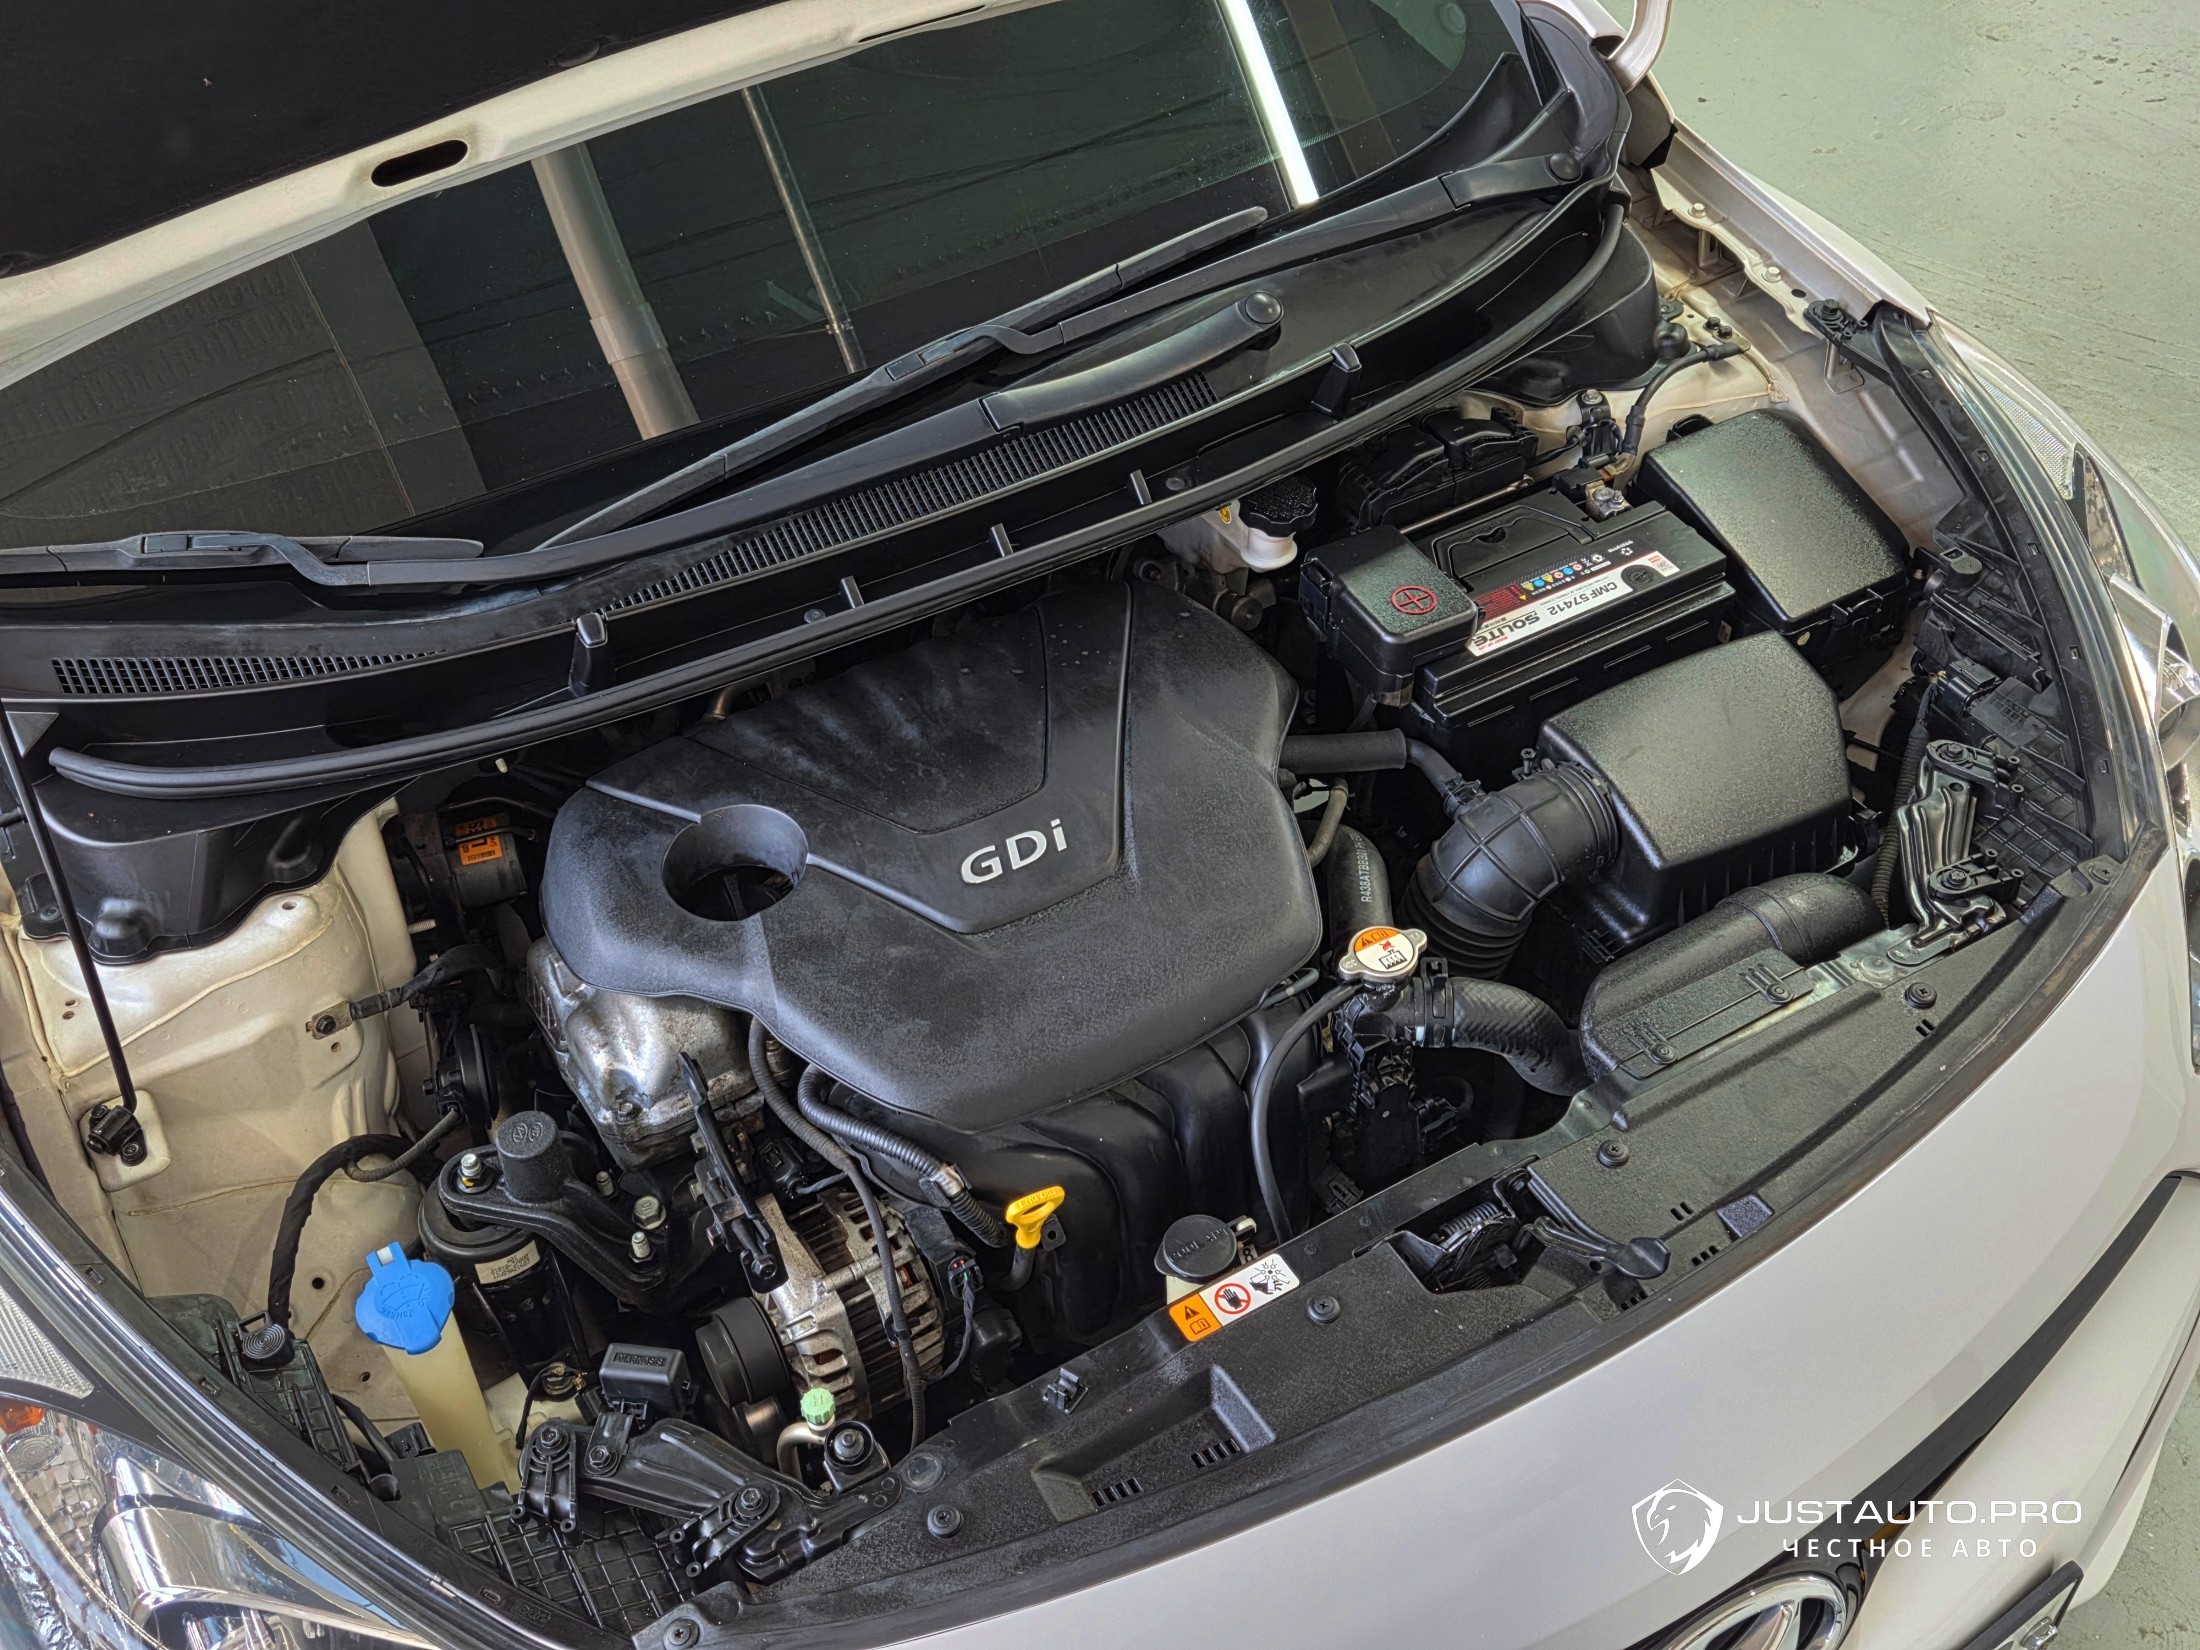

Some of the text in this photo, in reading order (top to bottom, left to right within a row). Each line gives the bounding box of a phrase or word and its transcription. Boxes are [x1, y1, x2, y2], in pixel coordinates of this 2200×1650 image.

[1588, 581, 1618, 599] CMF
[1547, 594, 1590, 616] 57412
[1473, 612, 1541, 647] SOLITE
[961, 818, 1067, 884] GDi
[1169, 1228, 1228, 1262] COOLANT
[381, 1306, 415, 1319] WASHER
[612, 1352, 667, 1368] DIAGNOSIS
